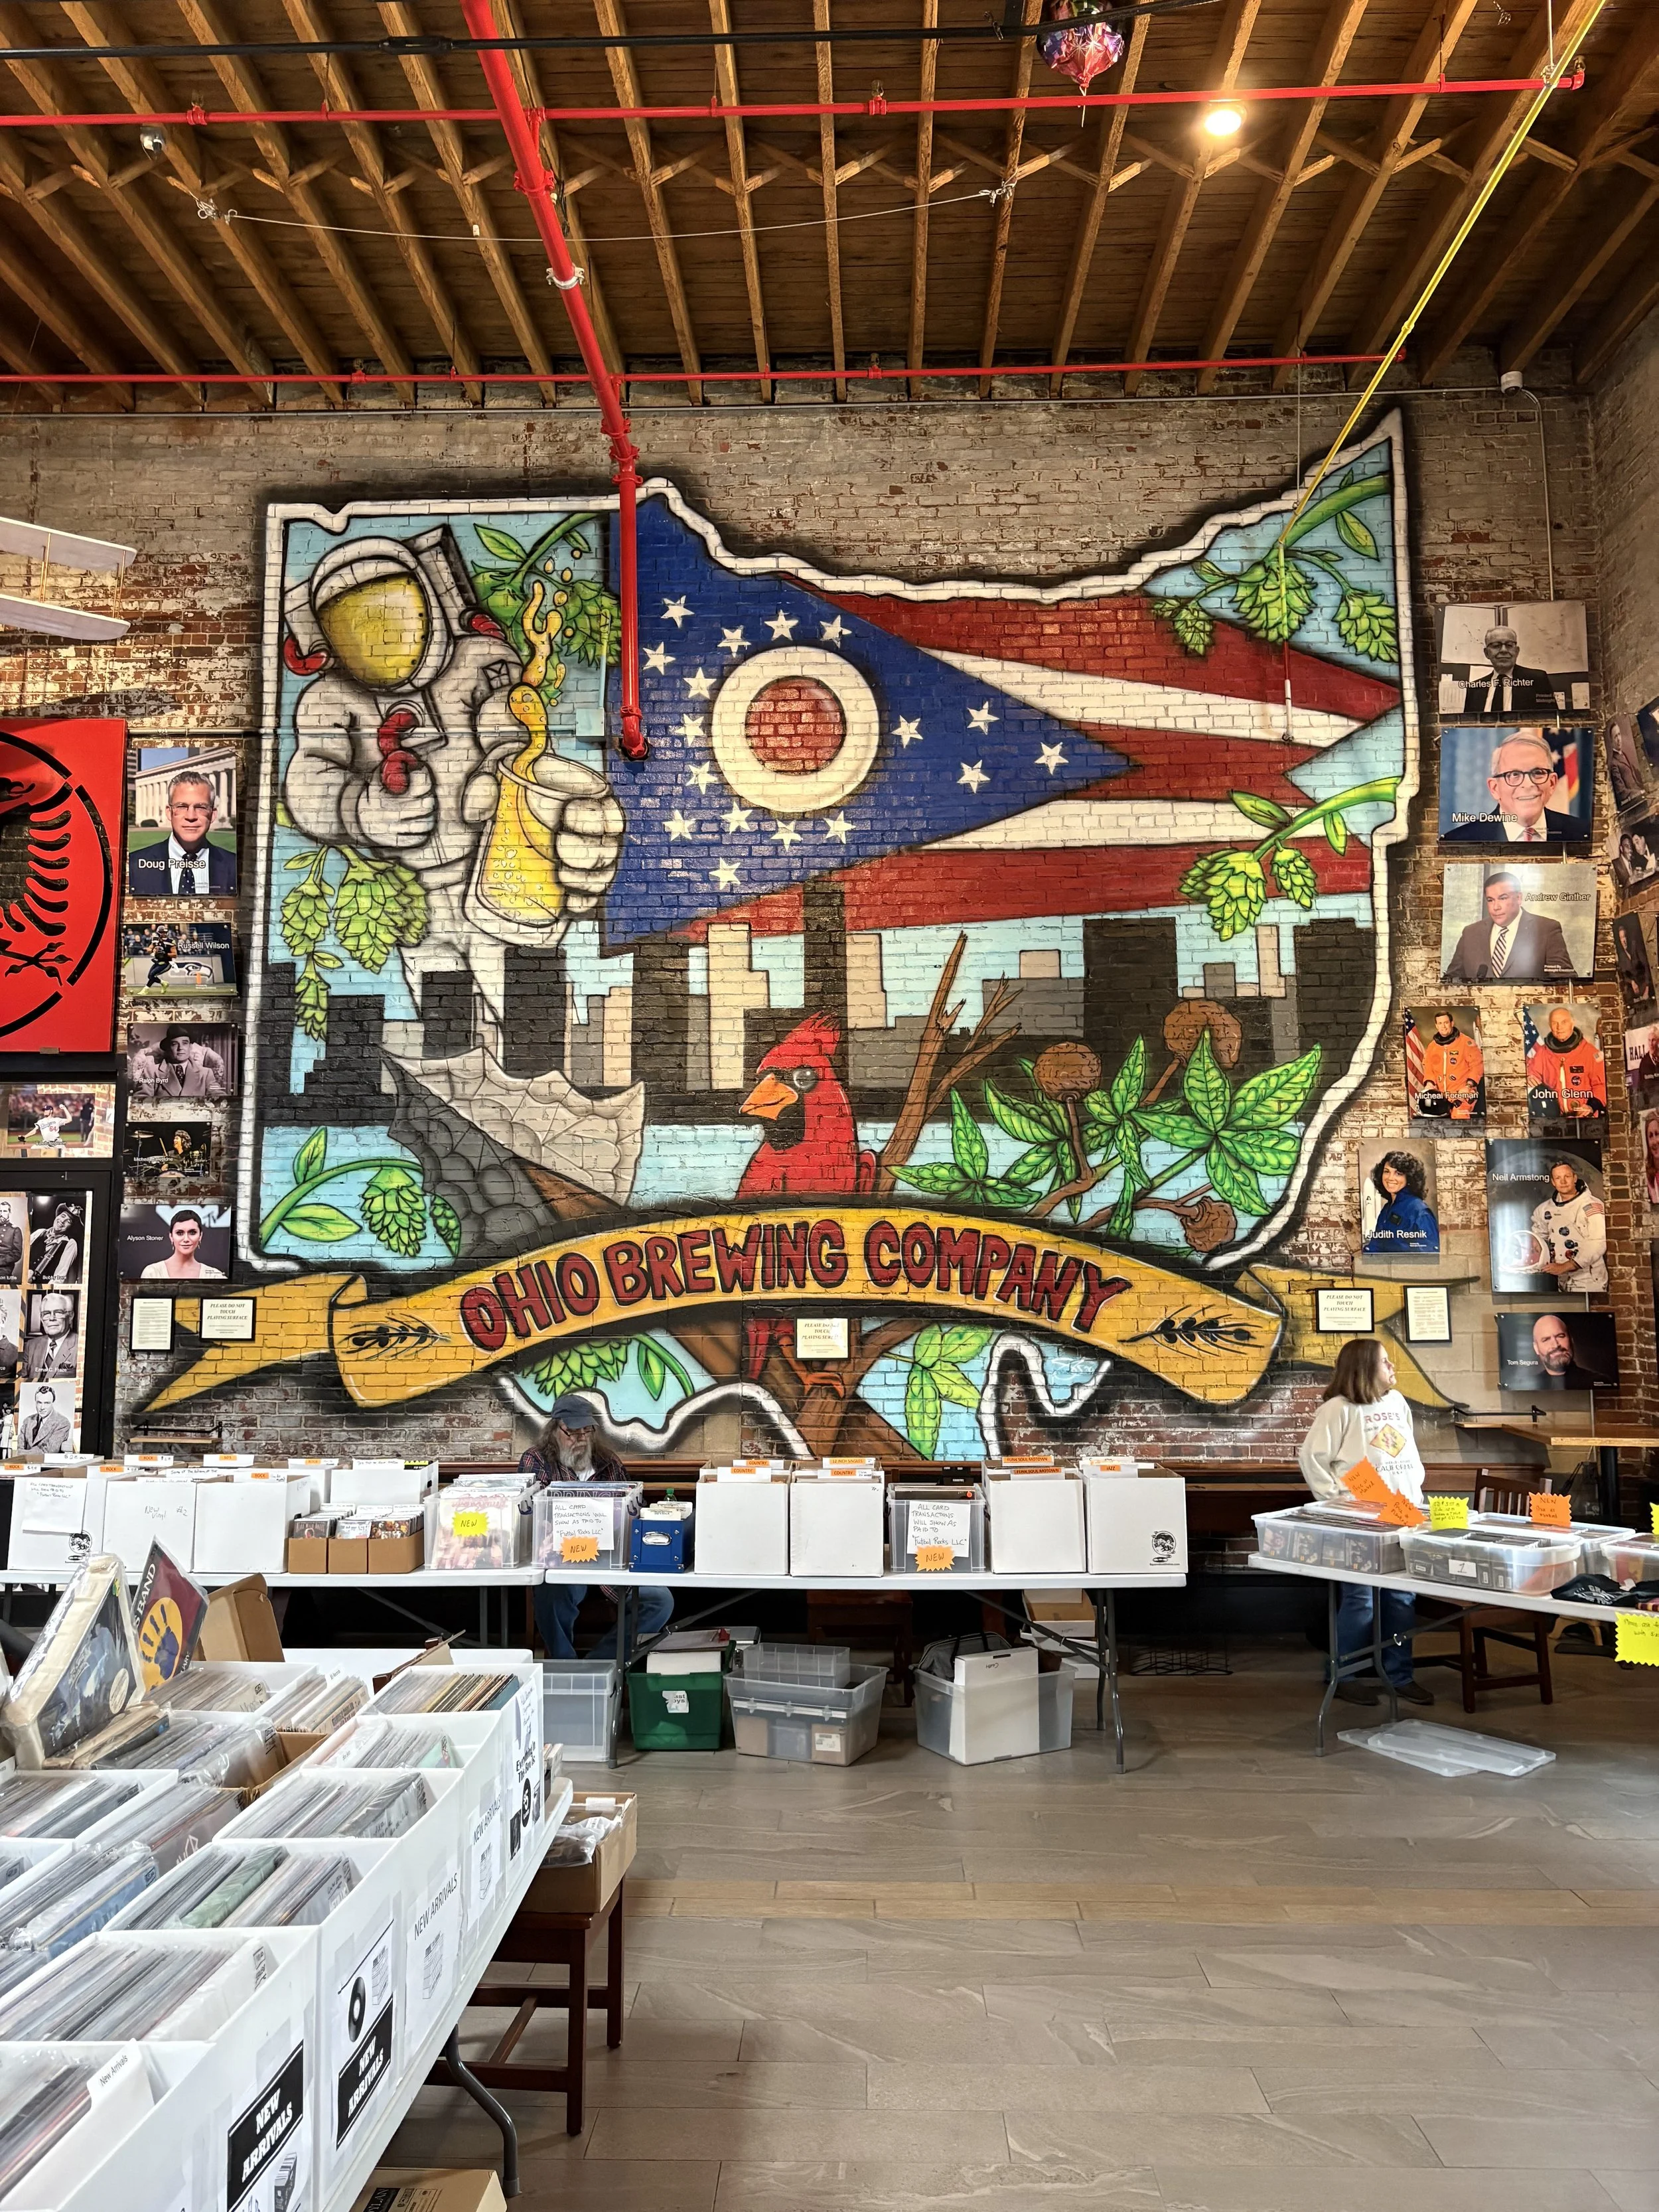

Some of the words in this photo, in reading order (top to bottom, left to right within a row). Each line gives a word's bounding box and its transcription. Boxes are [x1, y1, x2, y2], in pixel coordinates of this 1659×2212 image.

[1504, 678, 1534, 687] Richter
[1452, 812, 1477, 822] Mike
[1479, 812, 1518, 822] Dewine
[138, 859, 165, 870] Doug
[168, 859, 206, 869] Preisse
[1525, 893, 1557, 901] Andrew
[1559, 892, 1591, 901] Ginther
[1532, 1089, 1558, 1099] John
[1561, 1089, 1593, 1099] Glenn
[1492, 1173, 1508, 1182] Neil
[1510, 1173, 1550, 1183] Armstong
[1368, 1229, 1394, 1239] Judith
[1396, 1229, 1427, 1239] Resnik
[461, 1252, 599, 1351] OHIO
[603, 1219, 848, 1307] BREWING
[864, 1220, 1132, 1333] COMPANY
[1364, 1412, 1400, 1423] ROSE'S
[151, 1511, 166, 1520] Vinyl
[176, 1506, 188, 1516] #2
[911, 1510, 954, 1519] TRANSACTIONS
[570, 1545, 587, 1554] NEW
[926, 1552, 944, 1562] NEW
[137, 1563, 156, 1616] BAND
[516, 1747, 533, 1772] Everything
[523, 1789, 529, 1810] $5
[473, 1819, 484, 1845] NEW
[484, 1793, 501, 1830] ARRIVALS
[413, 1911, 429, 1941] NEW
[430, 1872, 458, 1919] ARRIVALS
[359, 2035, 376, 2077] NEW
[100, 2071, 111, 2087] New
[111, 2054, 128, 2076] Arrivals
[348, 2048, 384, 2118] ARRIVALS
[255, 2088, 281, 2134] NEW
[242, 2102, 293, 2182] ARRIVALS
